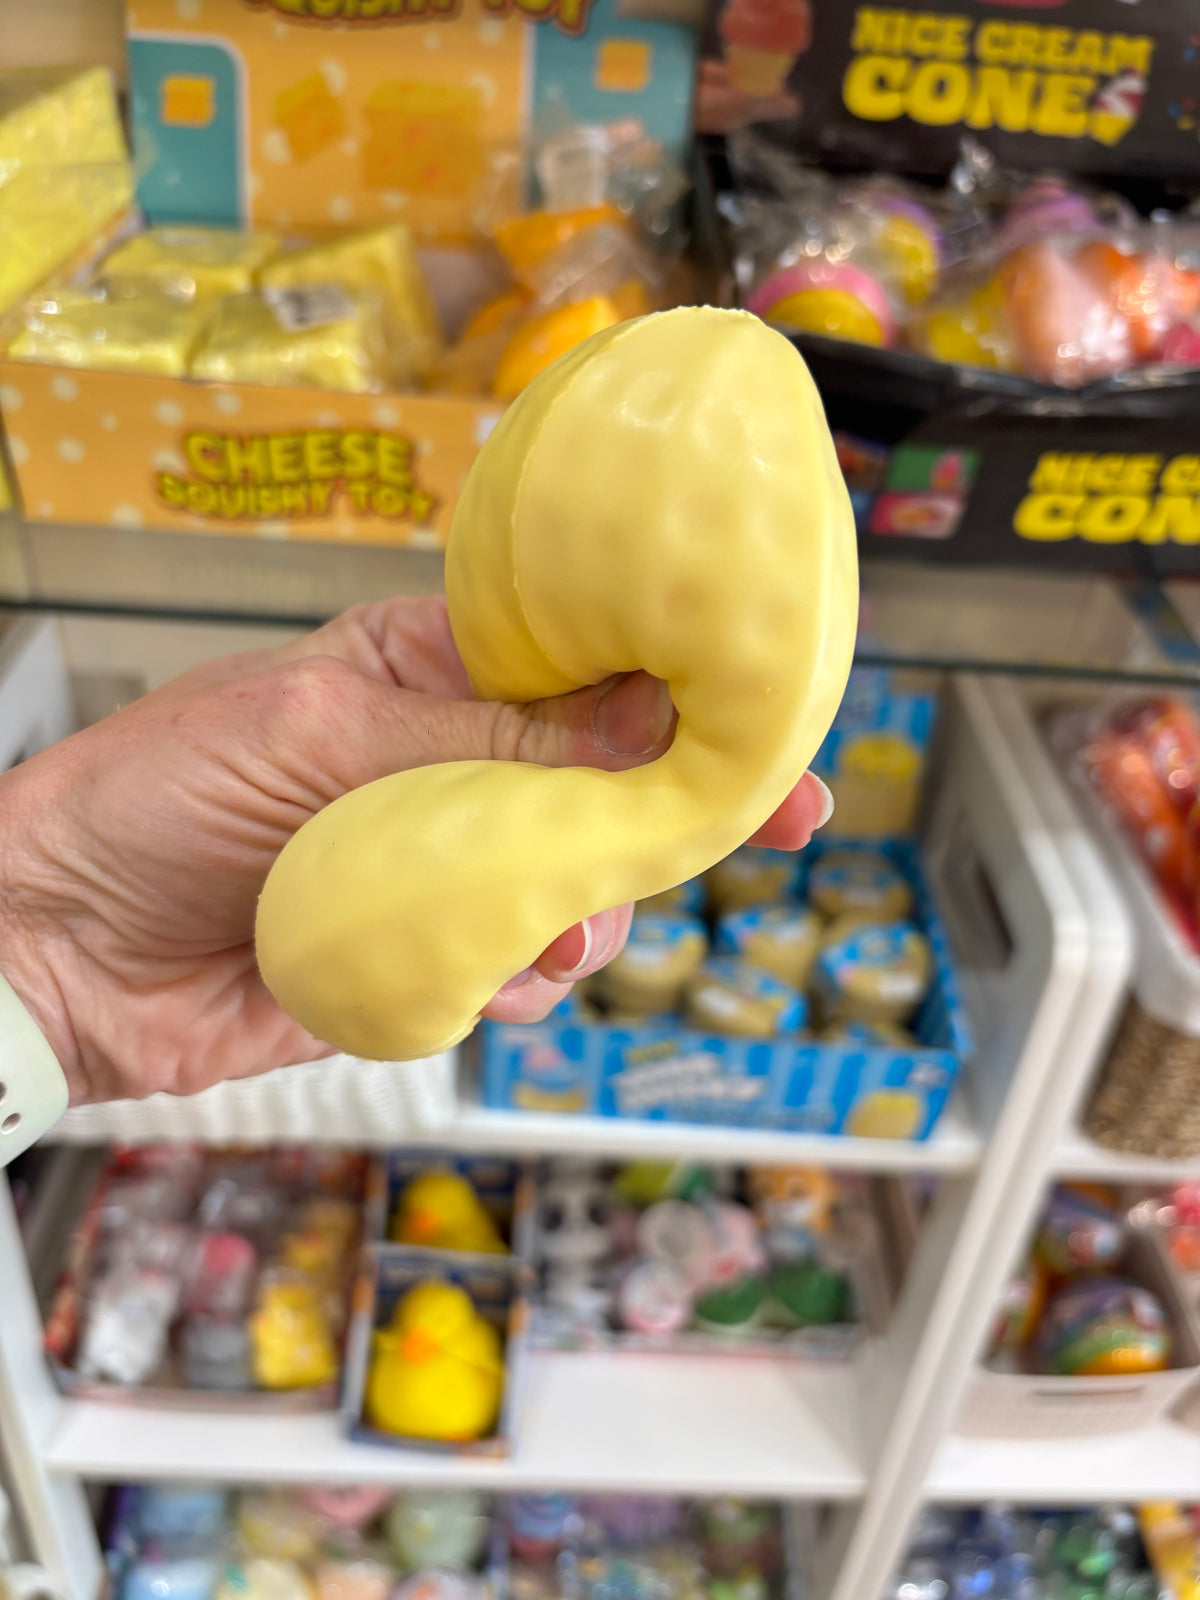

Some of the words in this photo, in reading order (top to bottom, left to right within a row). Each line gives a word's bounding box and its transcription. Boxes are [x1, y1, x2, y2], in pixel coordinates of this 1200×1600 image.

[853, 8, 971, 58] NICE
[974, 20, 1154, 76] CREAM
[186, 429, 411, 487] CHEESE
[1029, 453, 1158, 496] NICE
[156, 471, 336, 517] SQUISHY
[346, 479, 434, 522] TOY
